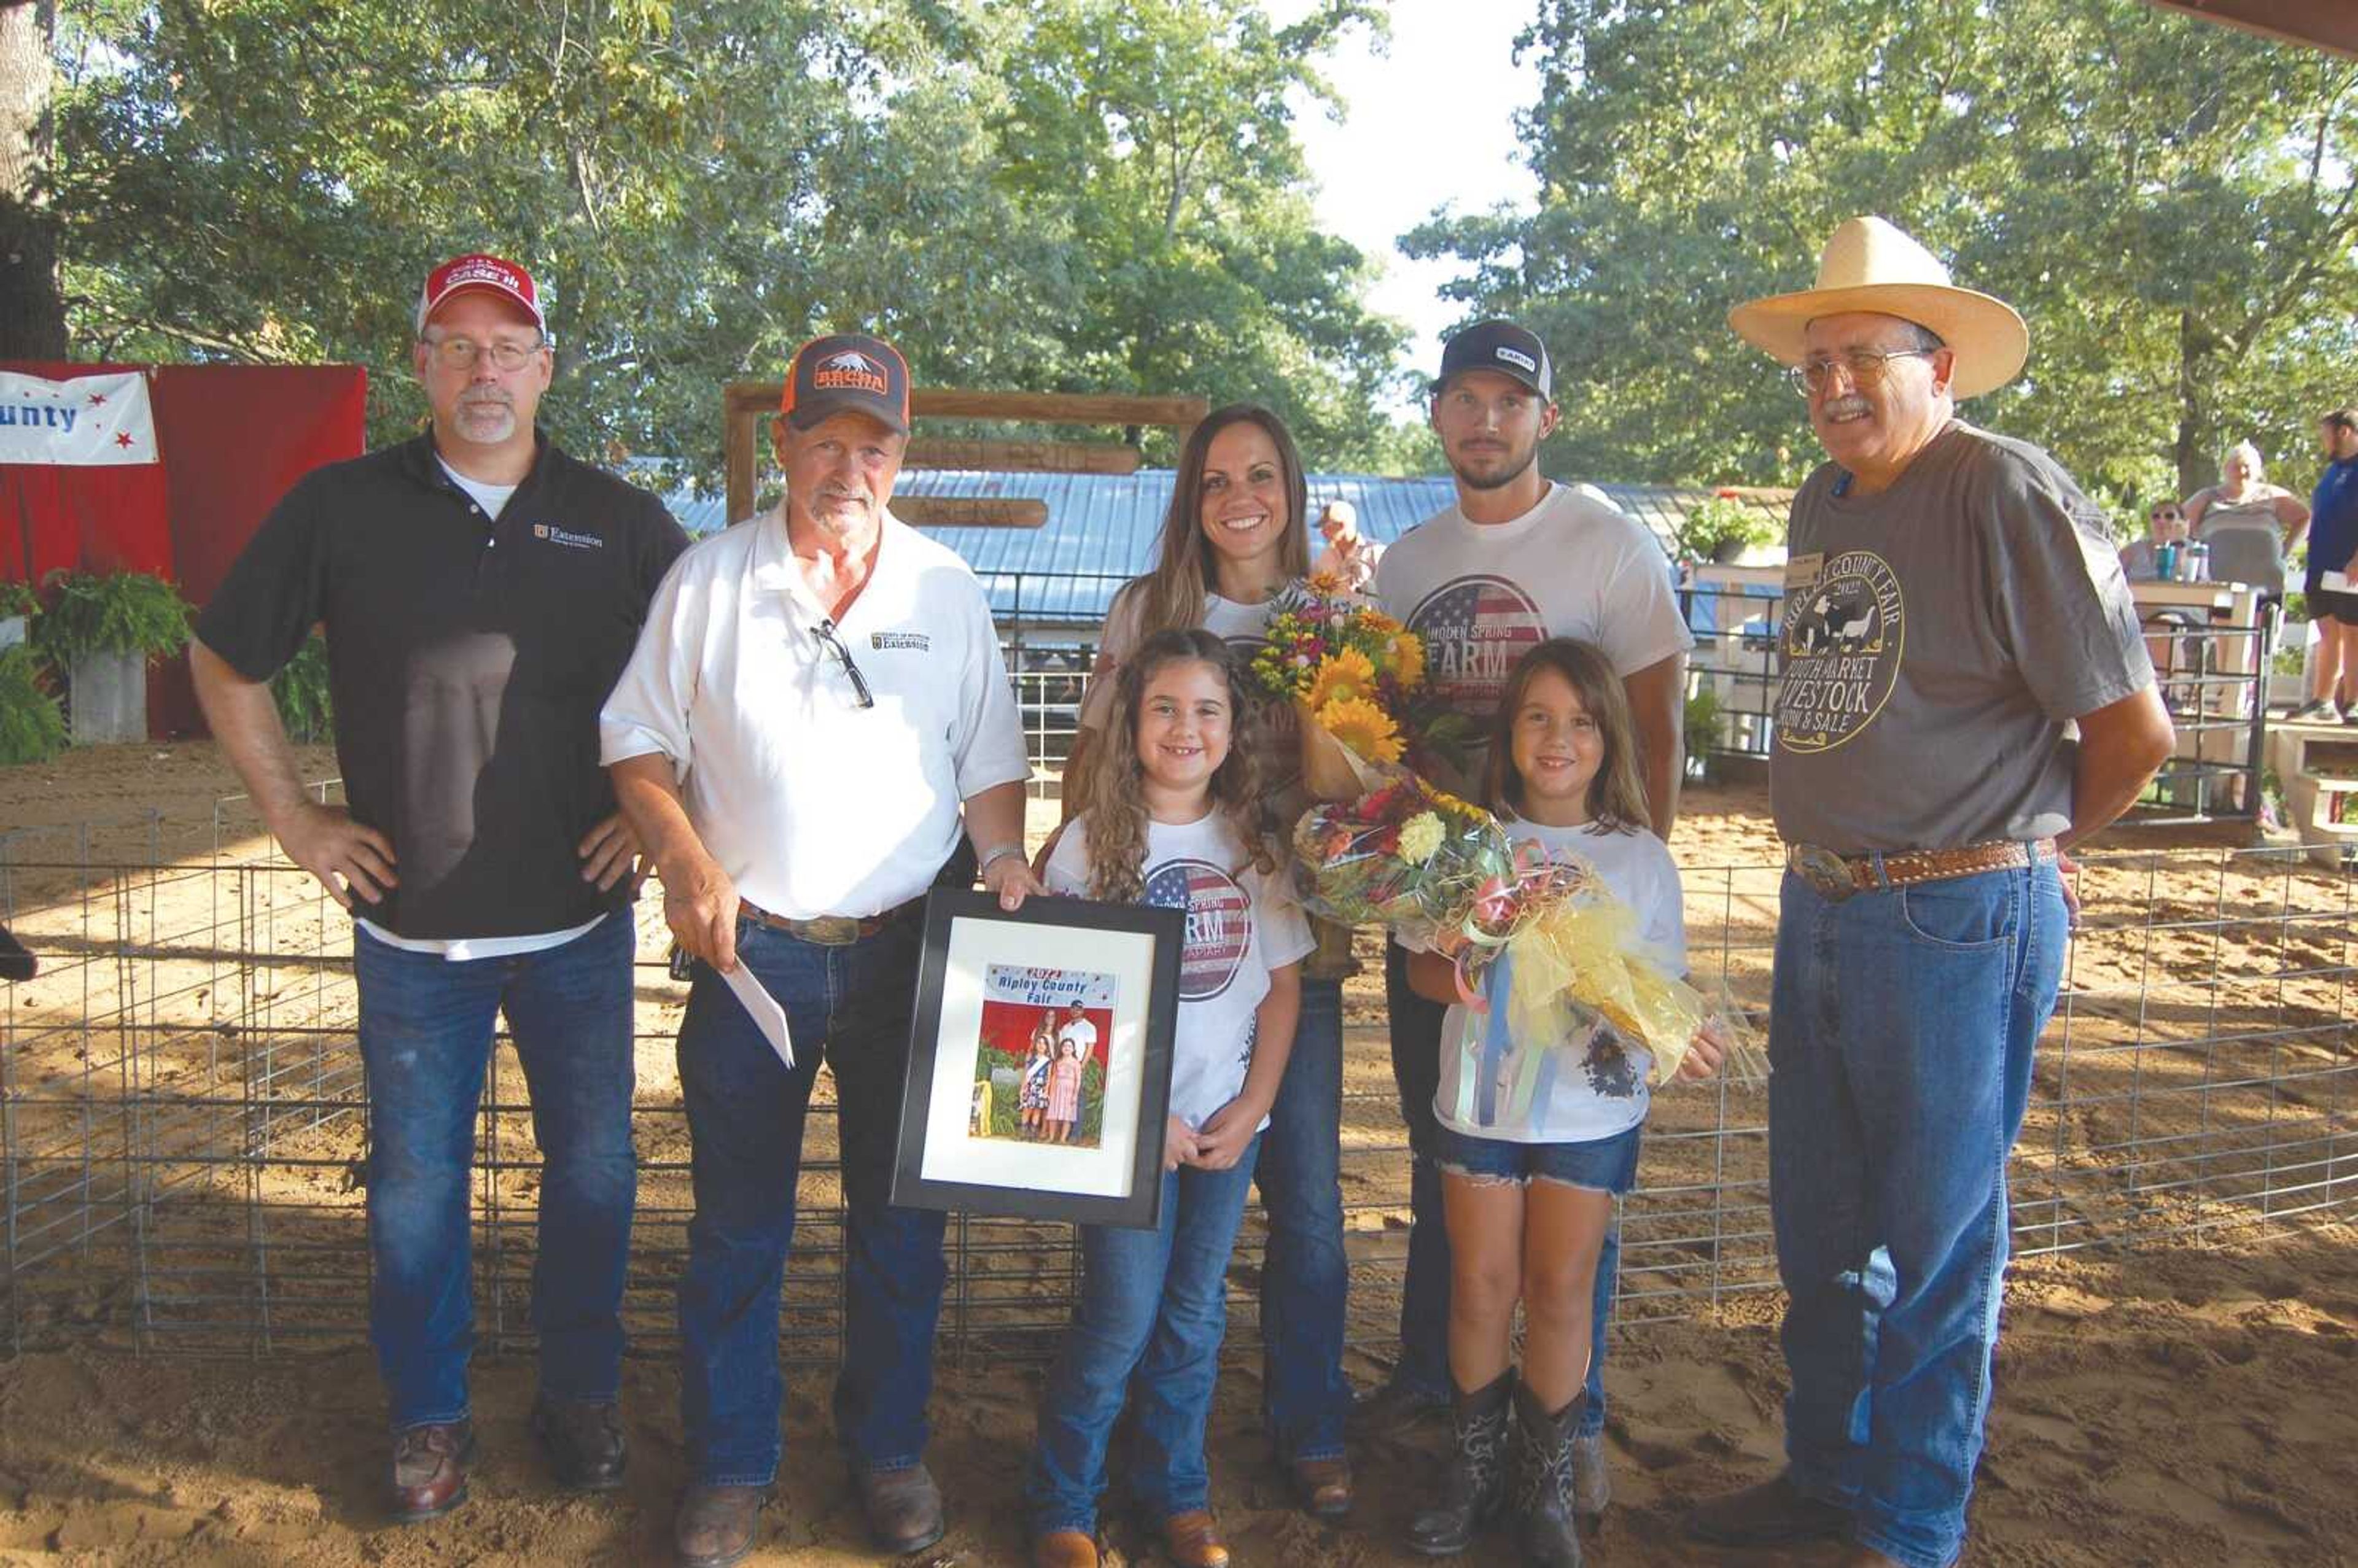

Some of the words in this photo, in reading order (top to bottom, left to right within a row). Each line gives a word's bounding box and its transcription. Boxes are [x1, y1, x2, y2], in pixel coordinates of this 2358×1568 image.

[1832, 556, 1886, 582] COUNTY
[1877, 578, 1901, 627] FAIR
[1471, 624, 1512, 638] SPRING
[1426, 640, 1507, 679] FARM
[1813, 712, 1851, 732] SALE
[1188, 896, 1224, 912] SPRING
[999, 976, 1038, 992] Ripley
[1042, 979, 1087, 995] County
[1027, 993, 1053, 1004] Fair
